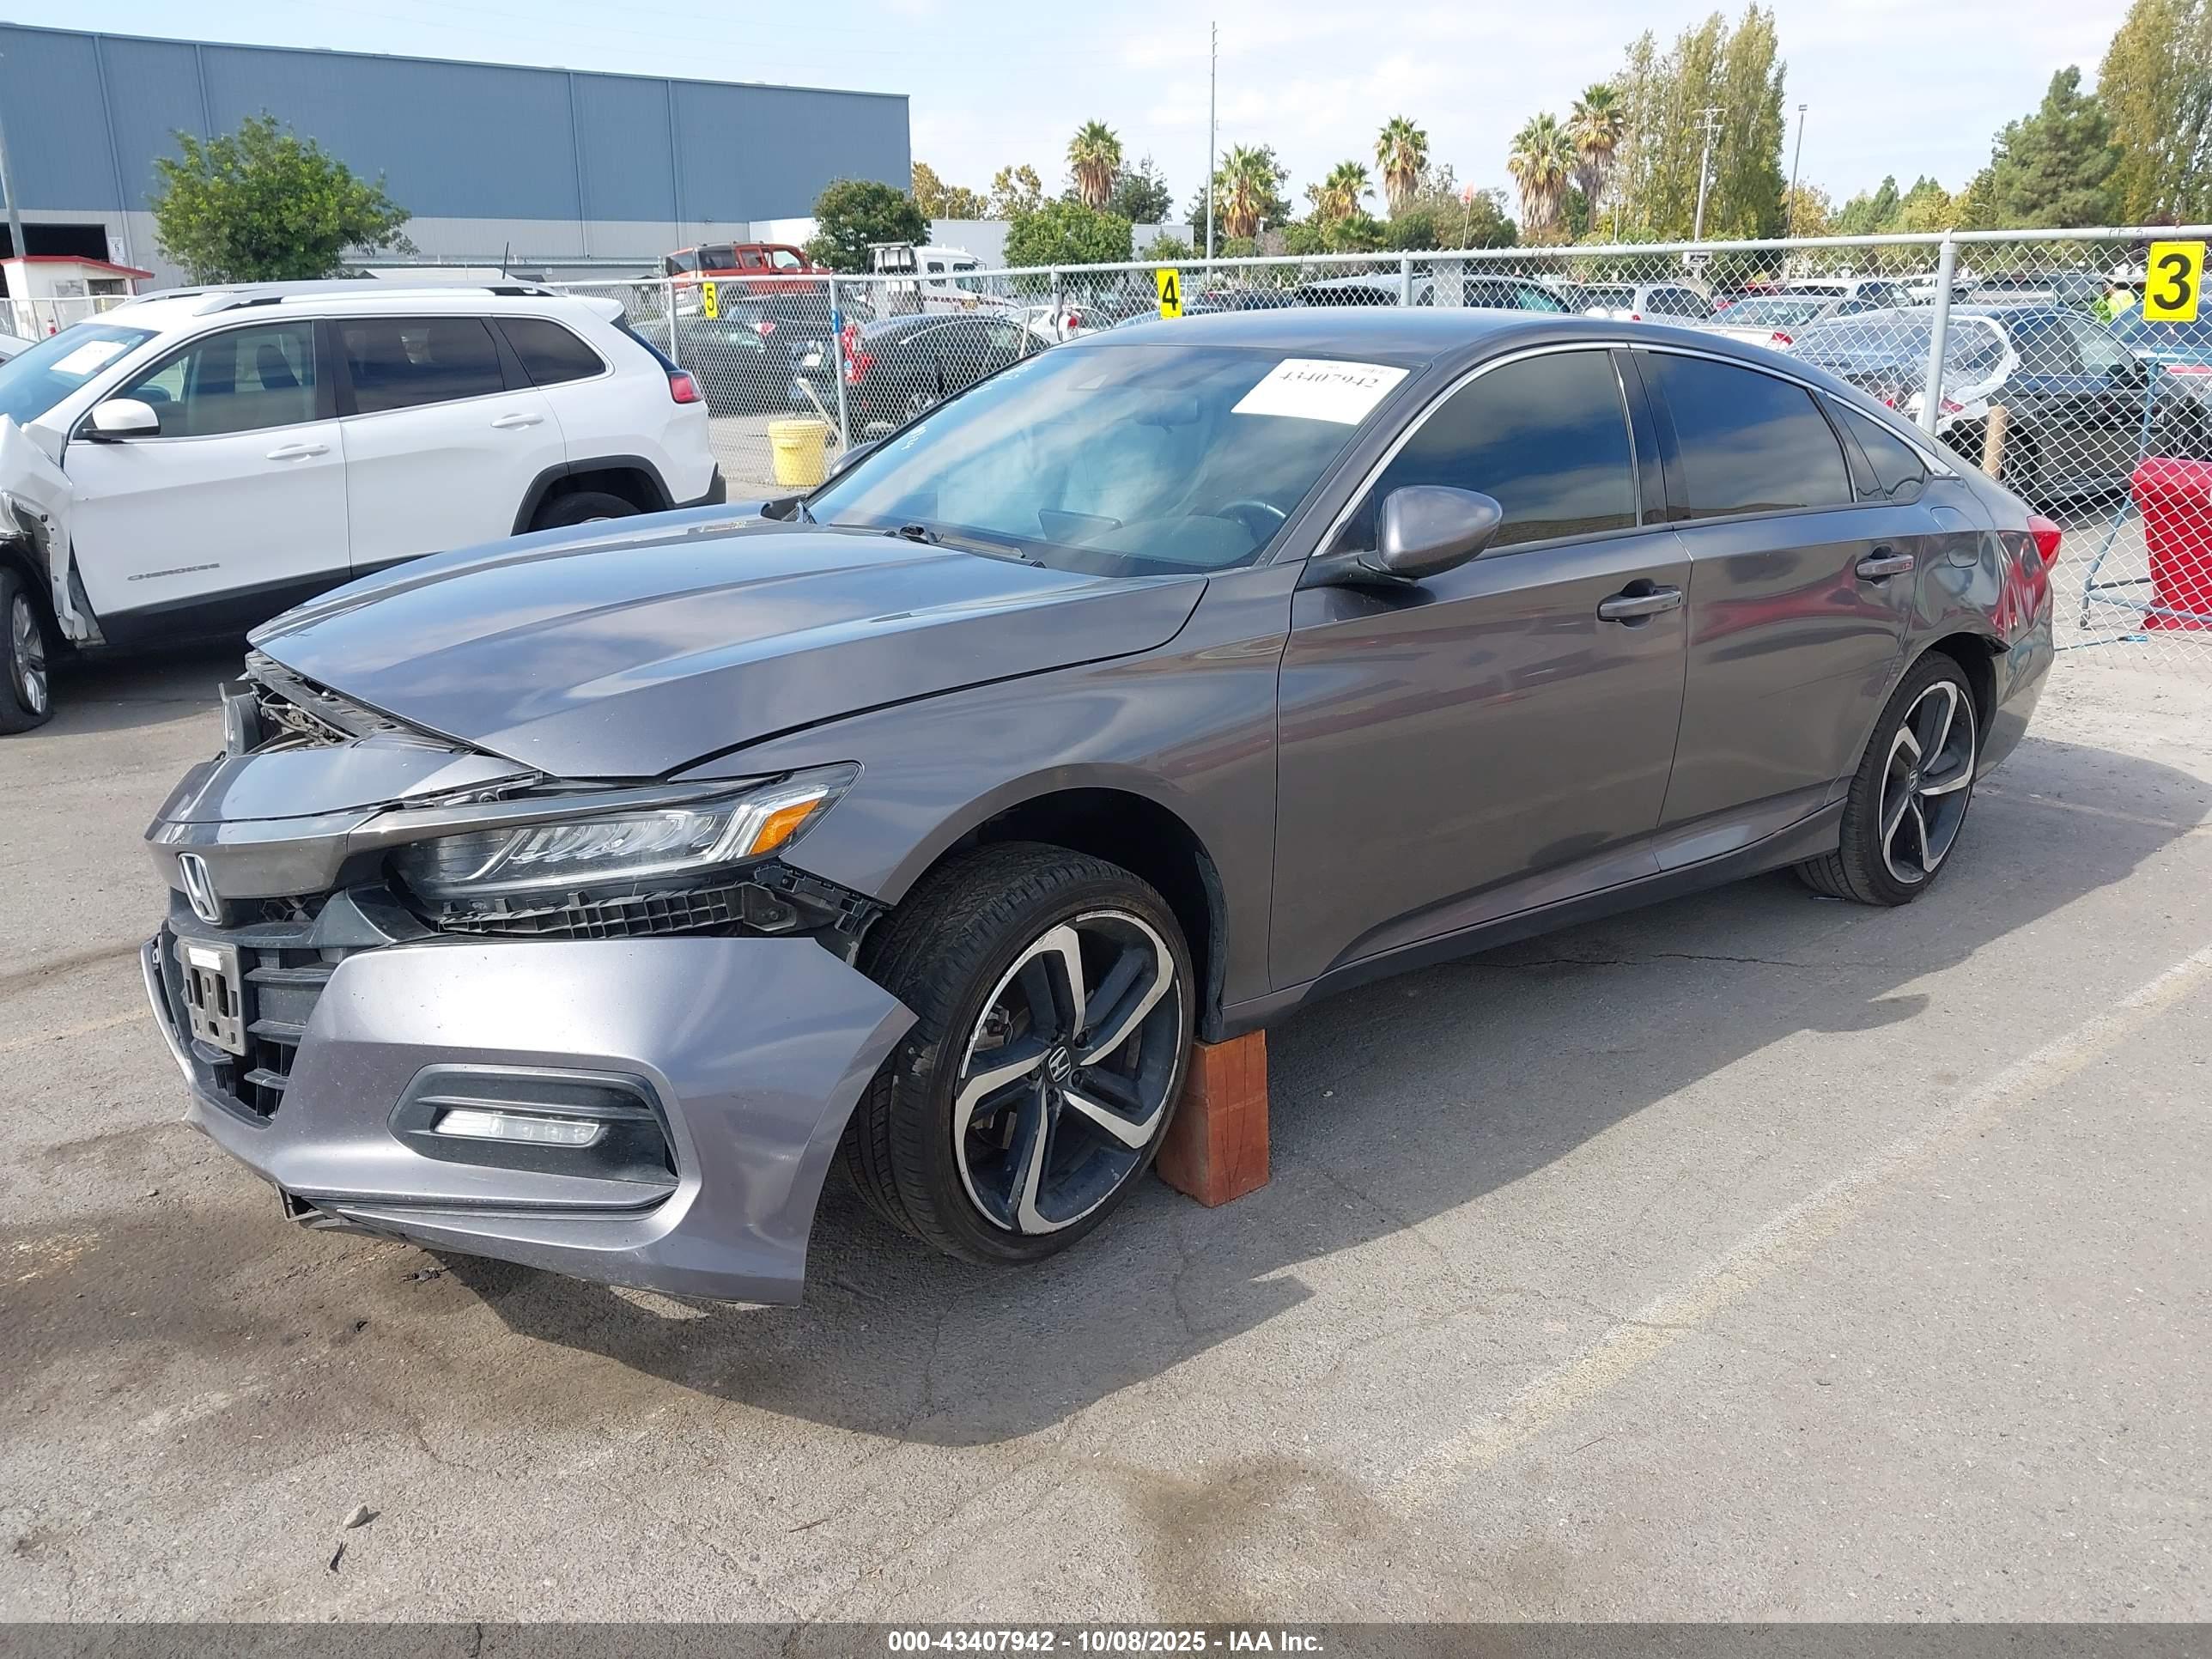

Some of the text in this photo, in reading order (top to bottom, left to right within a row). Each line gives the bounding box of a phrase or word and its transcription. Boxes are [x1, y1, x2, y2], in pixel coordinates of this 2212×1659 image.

[1162, 275, 1179, 311] 4
[2153, 252, 2192, 311] 3
[706, 287, 714, 312] 5
[127, 562, 221, 581] CHEROKEE
